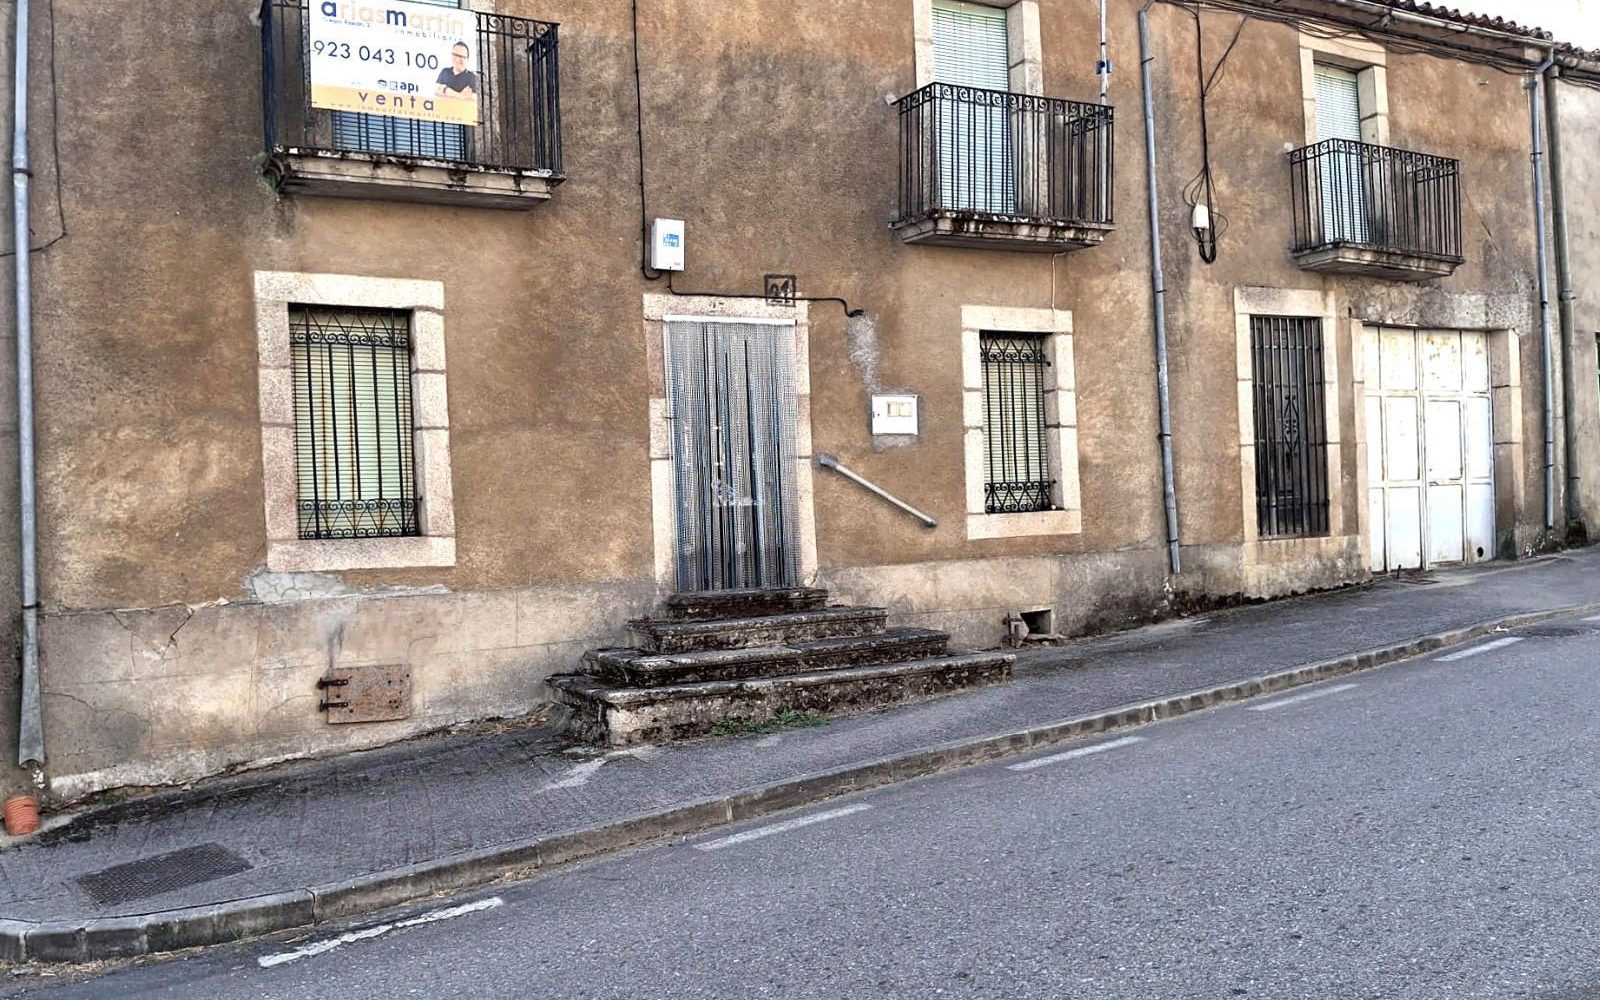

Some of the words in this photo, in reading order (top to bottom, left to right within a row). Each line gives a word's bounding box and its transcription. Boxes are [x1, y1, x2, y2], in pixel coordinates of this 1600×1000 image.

[313, 40, 351, 59] 923
[358, 45, 395, 65] 043
[404, 51, 439, 70] 100
[400, 81, 419, 94] api
[358, 91, 434, 111] venta
